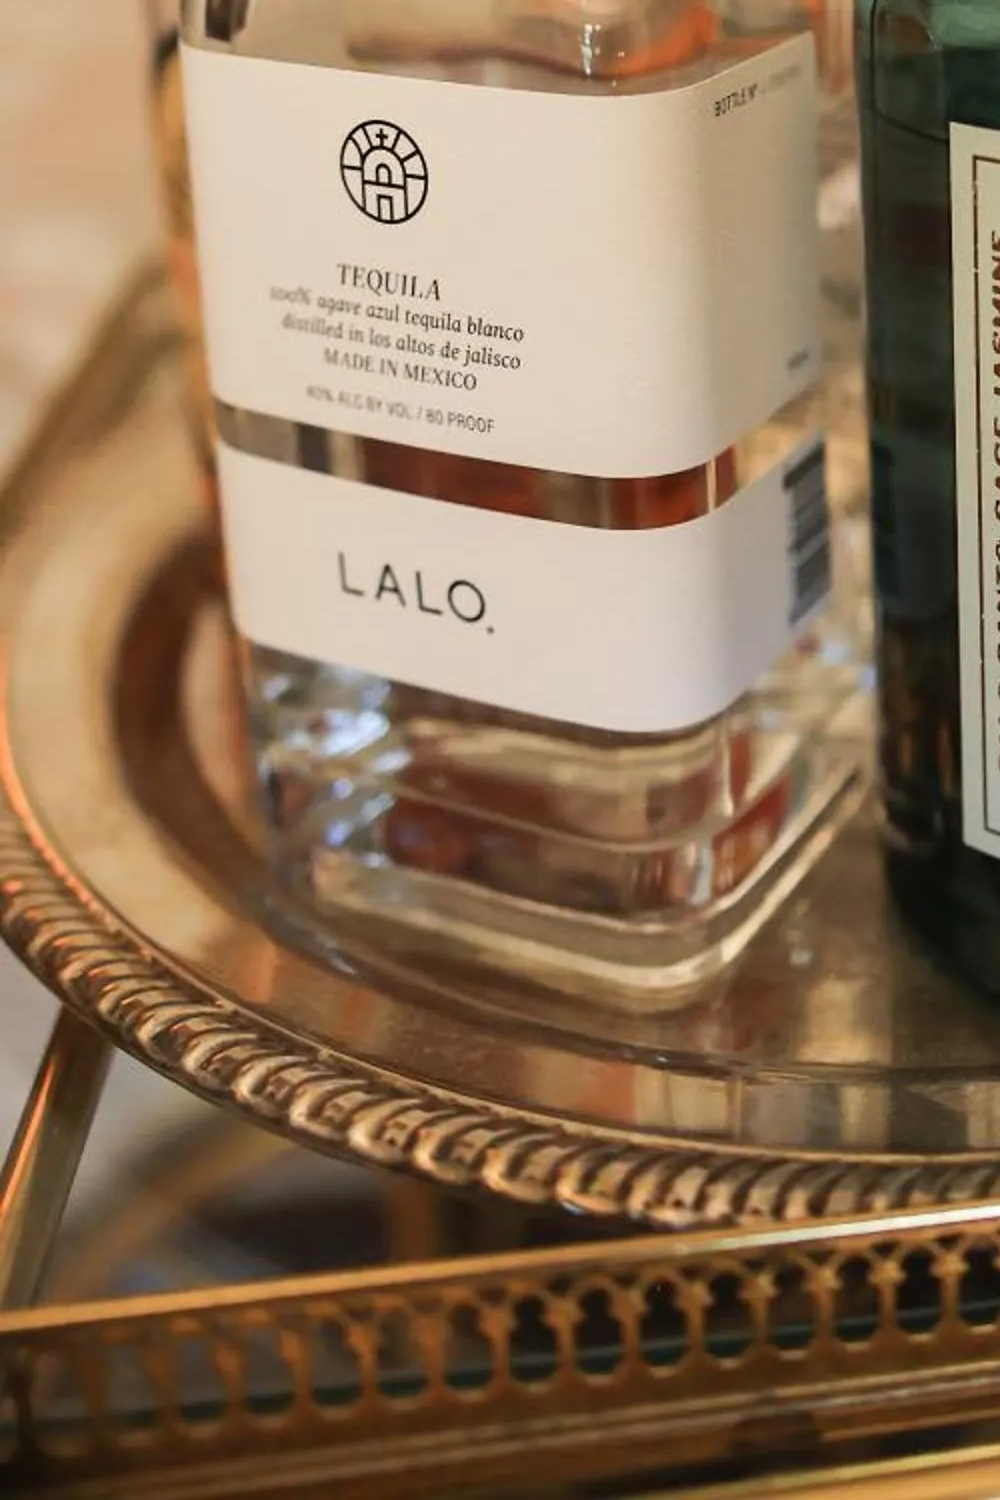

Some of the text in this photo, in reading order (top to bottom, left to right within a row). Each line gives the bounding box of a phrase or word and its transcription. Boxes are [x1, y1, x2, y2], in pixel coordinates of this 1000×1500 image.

[336, 263, 441, 301] TEQUILA
[317, 294, 361, 317] agave
[366, 303, 399, 324] azul
[405, 309, 461, 334] tequila
[467, 315, 525, 342] blanco
[323, 348, 477, 391] MADE IN MEXICO
[349, 325, 364, 342] in
[369, 328, 391, 348] los
[396, 334, 435, 356] altos
[440, 341, 460, 360] de
[464, 347, 522, 370] jalisco
[426, 408, 443, 425] 80
[448, 411, 496, 434] PROOF
[337, 551, 496, 634] LALO.
